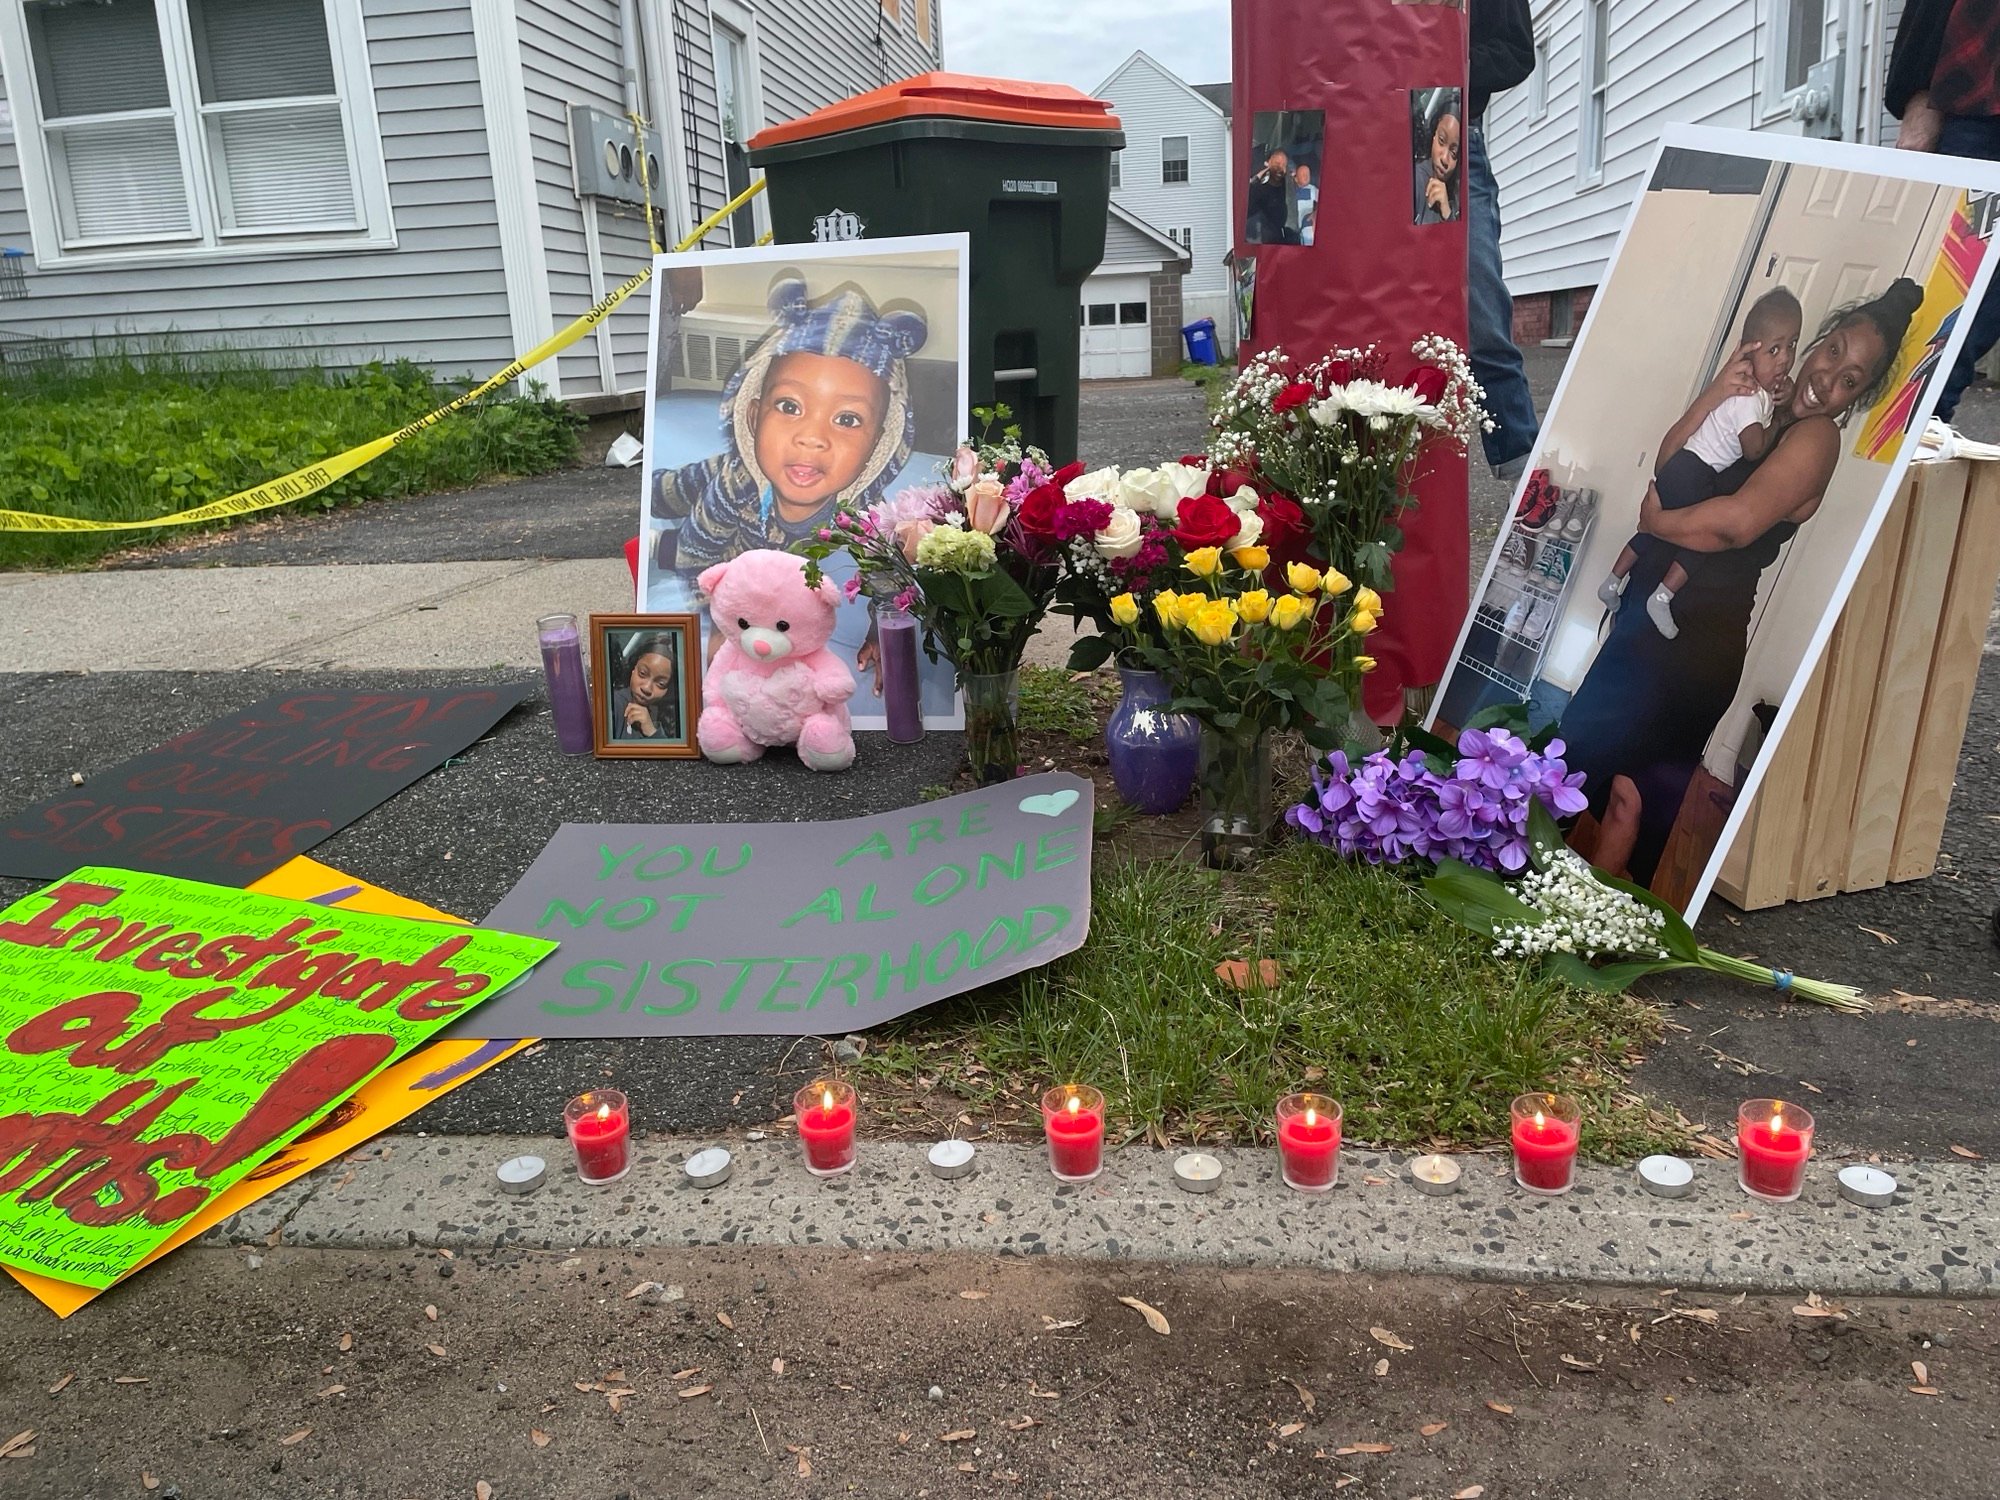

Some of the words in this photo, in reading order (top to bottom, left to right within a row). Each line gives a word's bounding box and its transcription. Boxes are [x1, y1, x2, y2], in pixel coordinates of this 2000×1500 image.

[815, 212, 863, 241] HQ
[9, 799, 332, 866] SISTERS
[596, 840, 753, 882] YOU
[835, 803, 994, 867] ARE
[534, 893, 724, 933] NOT
[780, 826, 1083, 929] ALONE
[0, 883, 492, 1030] Investigate
[539, 903, 1073, 1017] SISTERHOOD
[22, 1227, 79, 1248] and
[61, 1234, 129, 1258] called
